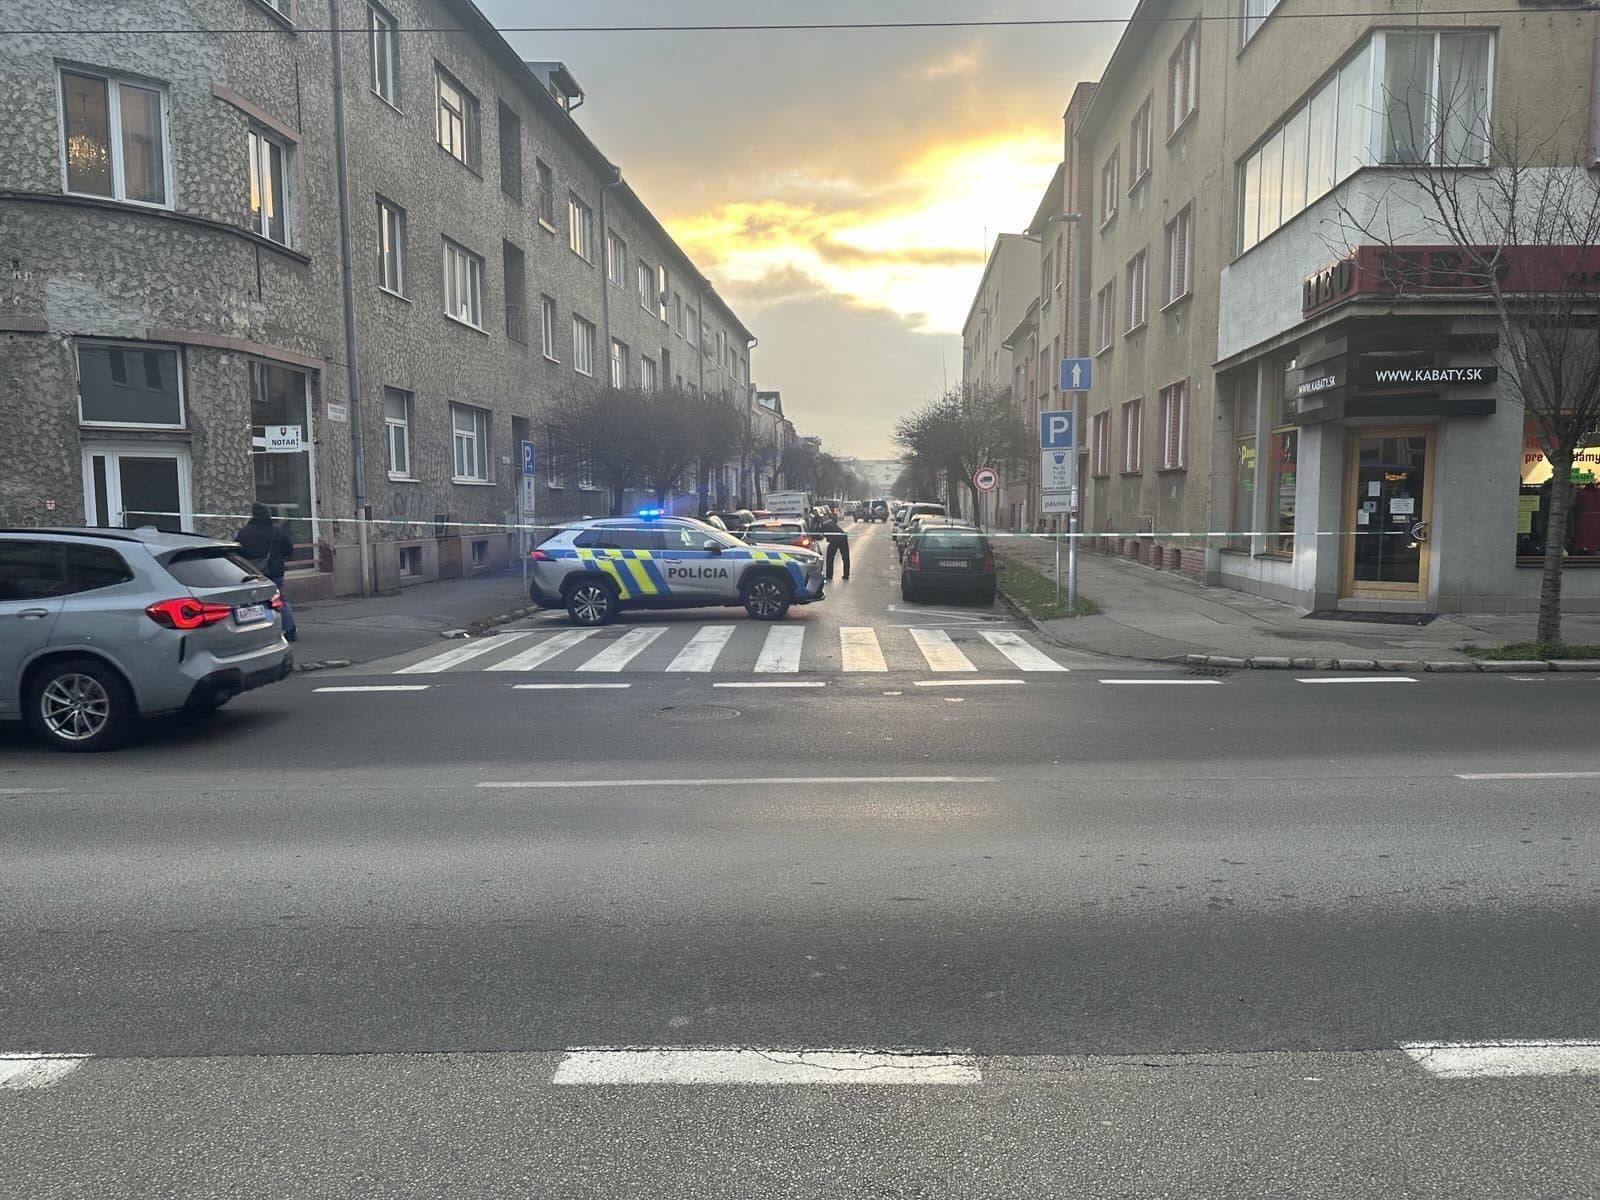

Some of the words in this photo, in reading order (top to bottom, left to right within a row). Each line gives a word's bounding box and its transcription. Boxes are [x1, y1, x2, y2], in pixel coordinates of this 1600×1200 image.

[1375, 368, 1482, 382] WWW.KABATY.SK
[1049, 416, 1069, 444] P
[525, 445, 532, 471] P
[1525, 452, 1543, 464] pre
[668, 564, 729, 579] POLÍCIA
